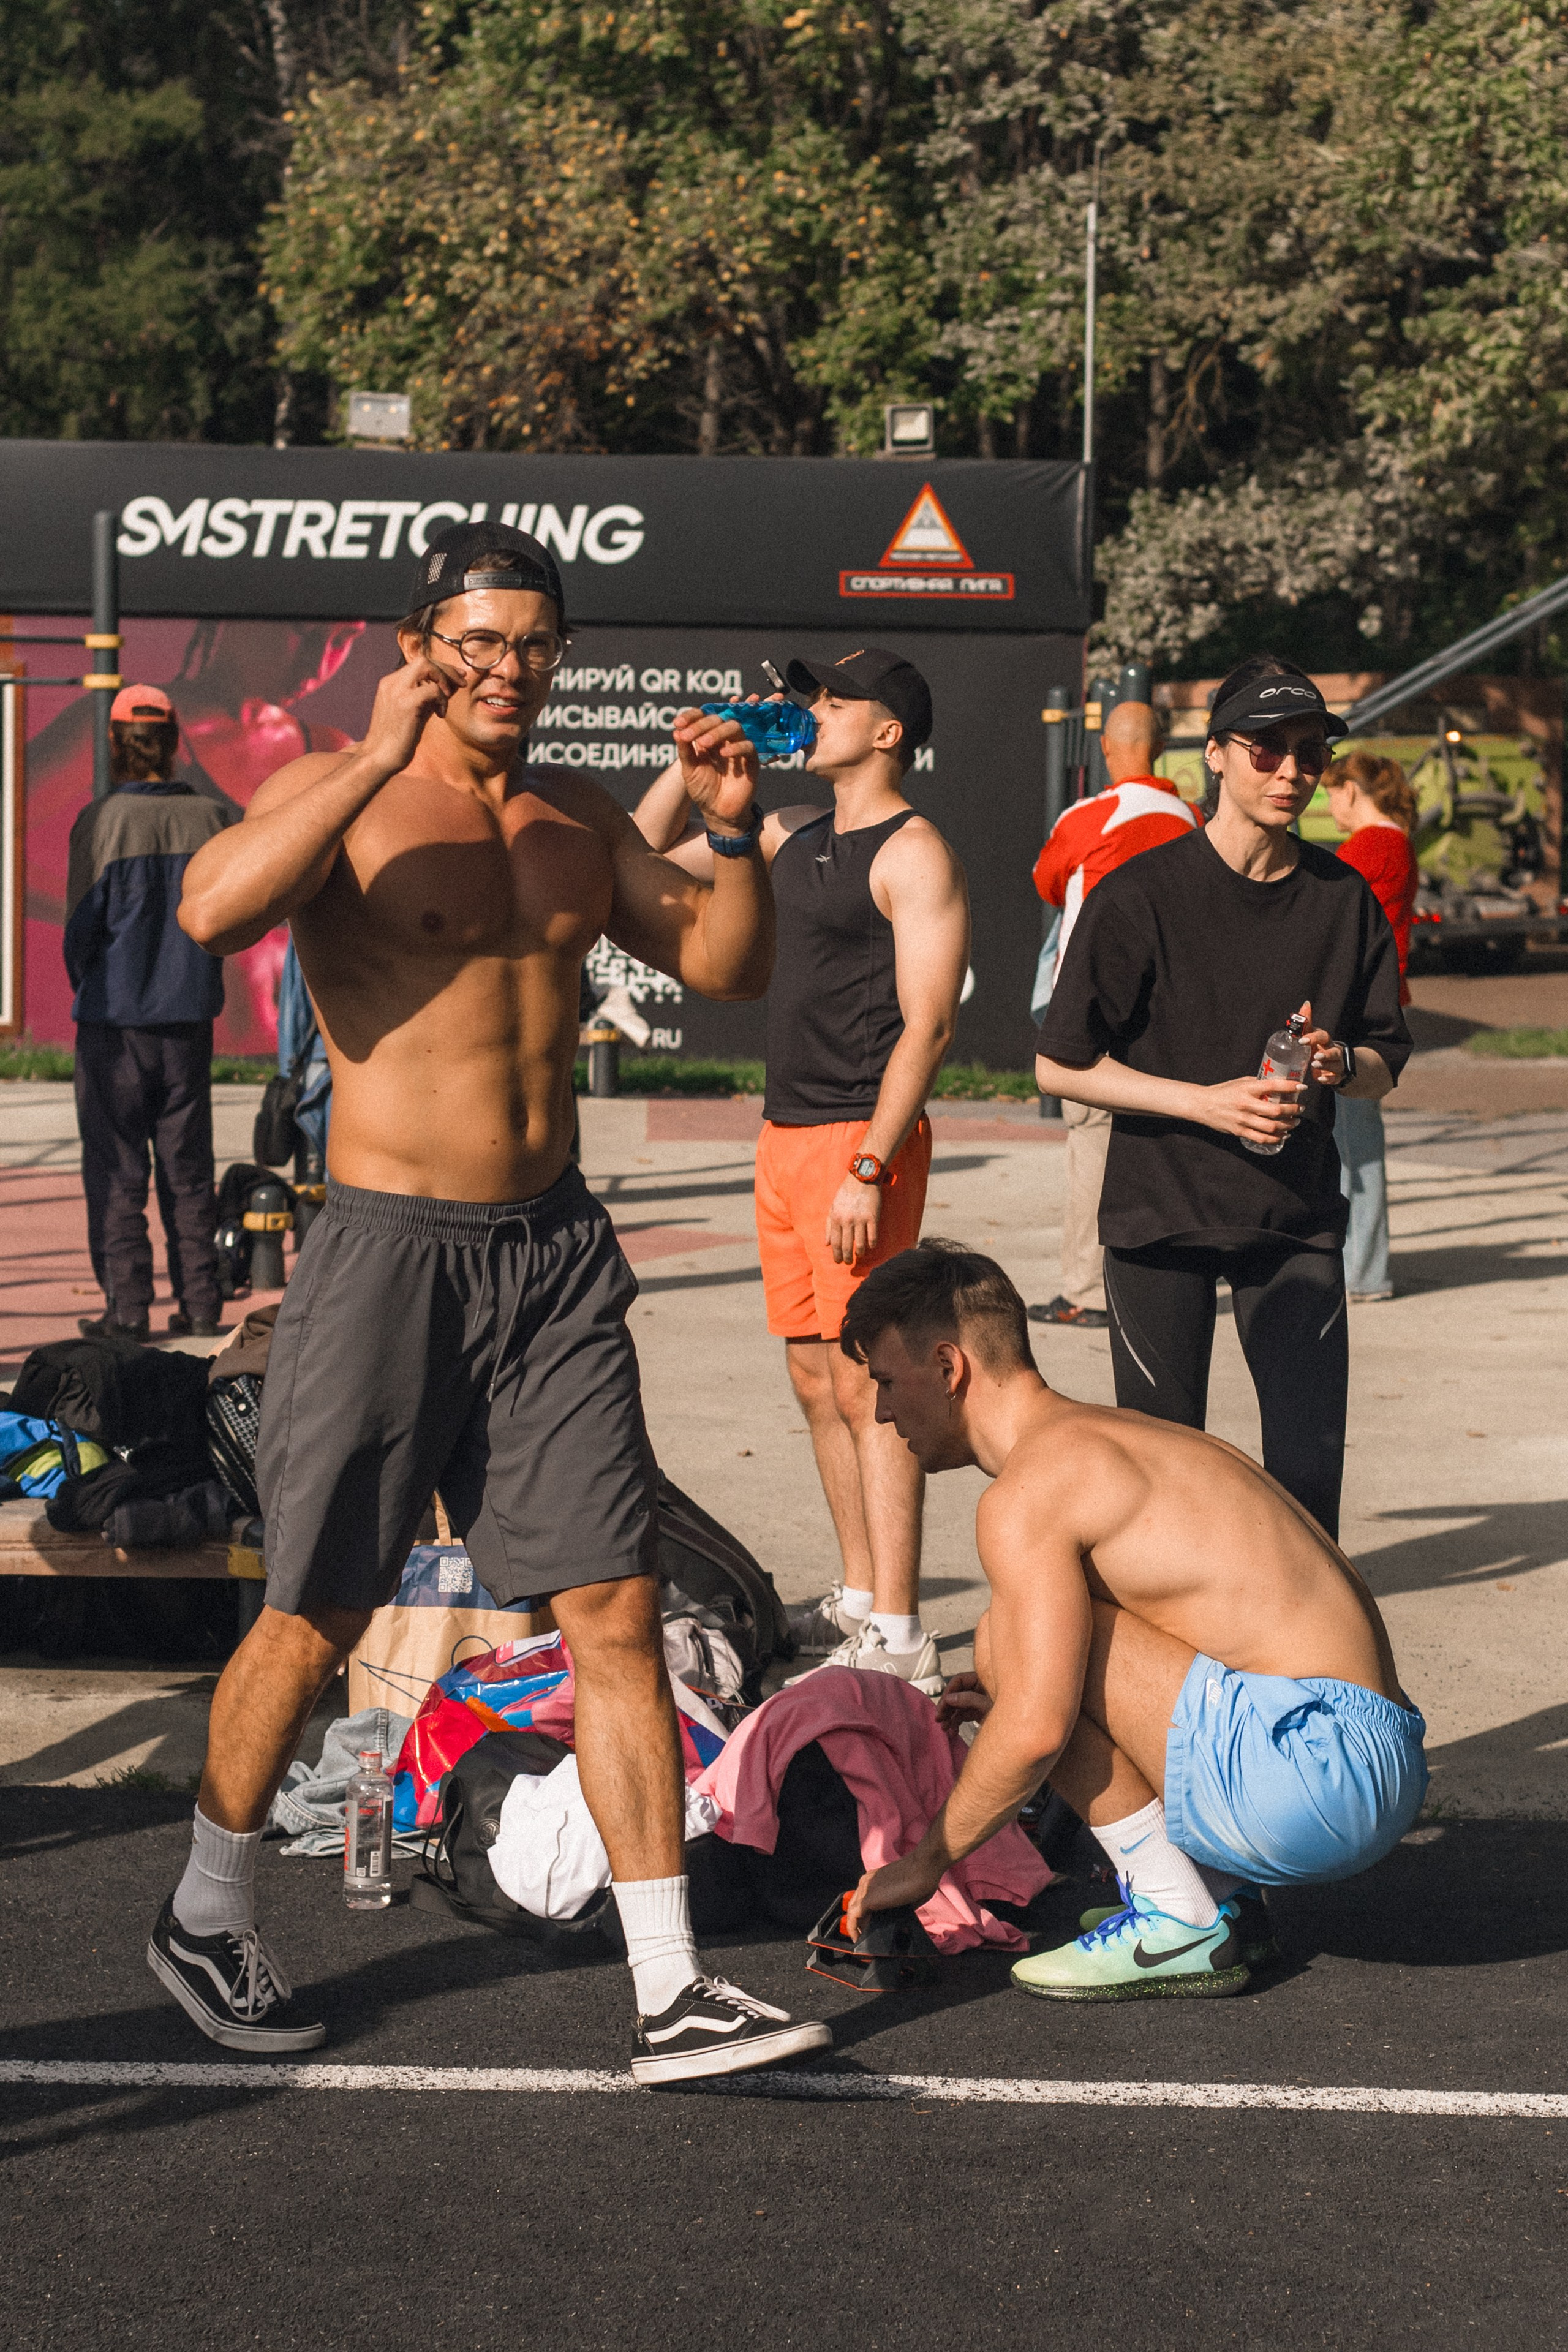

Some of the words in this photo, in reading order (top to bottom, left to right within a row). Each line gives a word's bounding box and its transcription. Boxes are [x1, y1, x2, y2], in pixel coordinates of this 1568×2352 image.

[640, 668, 681, 693] QR
[687, 669, 744, 697] КОД
[535, 702, 693, 730] ИСЫВАЙС
[527, 741, 679, 771] ИСОЕДИНЯ
[652, 1028, 682, 1049] RU
